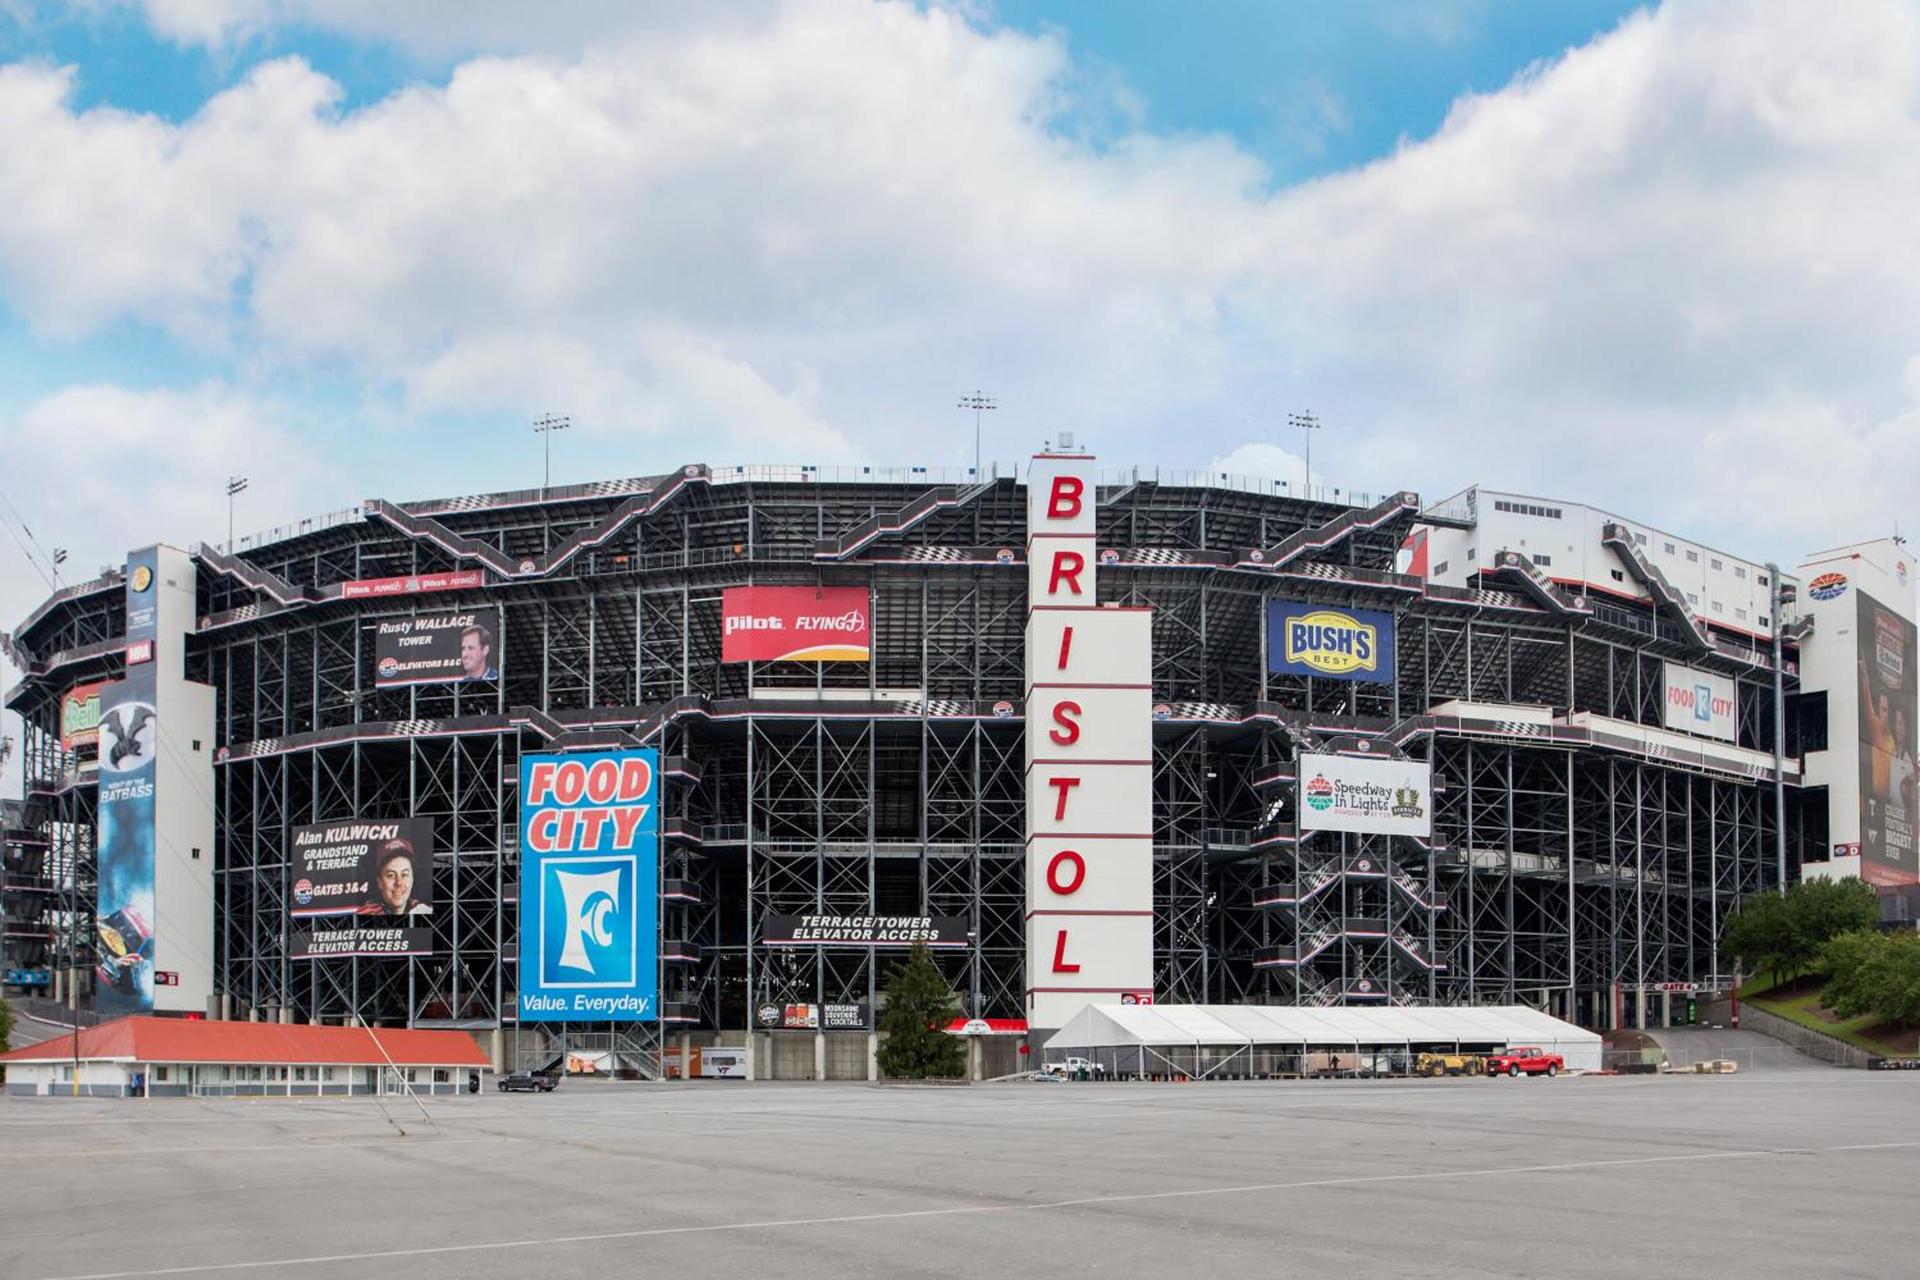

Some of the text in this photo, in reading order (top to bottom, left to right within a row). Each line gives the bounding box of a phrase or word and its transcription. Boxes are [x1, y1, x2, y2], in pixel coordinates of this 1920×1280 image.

[380, 615, 475, 634] Rusty WALLACE
[725, 615, 783, 635] pilot
[398, 635, 433, 647] TOWER
[1292, 623, 1371, 660] BUSH'S
[398, 659, 442, 671] ELEVATORS
[1314, 655, 1349, 665] BEST
[1668, 687, 1695, 708] FOOD
[1711, 697, 1733, 717] CITY
[1047, 476, 1086, 974] BRISTOL
[527, 758, 652, 806] FOOD
[1335, 779, 1392, 800] Speedway
[101, 784, 153, 803] BATBASS
[1335, 794, 1388, 815] In Lights
[296, 825, 399, 846] Alan KULWICKI
[527, 804, 651, 853] CITY
[1885, 829, 1912, 849] BIGGEST
[304, 845, 369, 861] GRANDSTAND
[306, 857, 359, 871] & TERRACE
[314, 884, 343, 896] GATES
[801, 916, 931, 928] TERRACE/TOWER
[313, 929, 403, 942] TERRACE/TOWER
[792, 928, 939, 940] ELEVATOR ACCESS
[308, 941, 409, 953] ELEVATOR ACCESS
[523, 994, 650, 1014] Value. Everyday.
